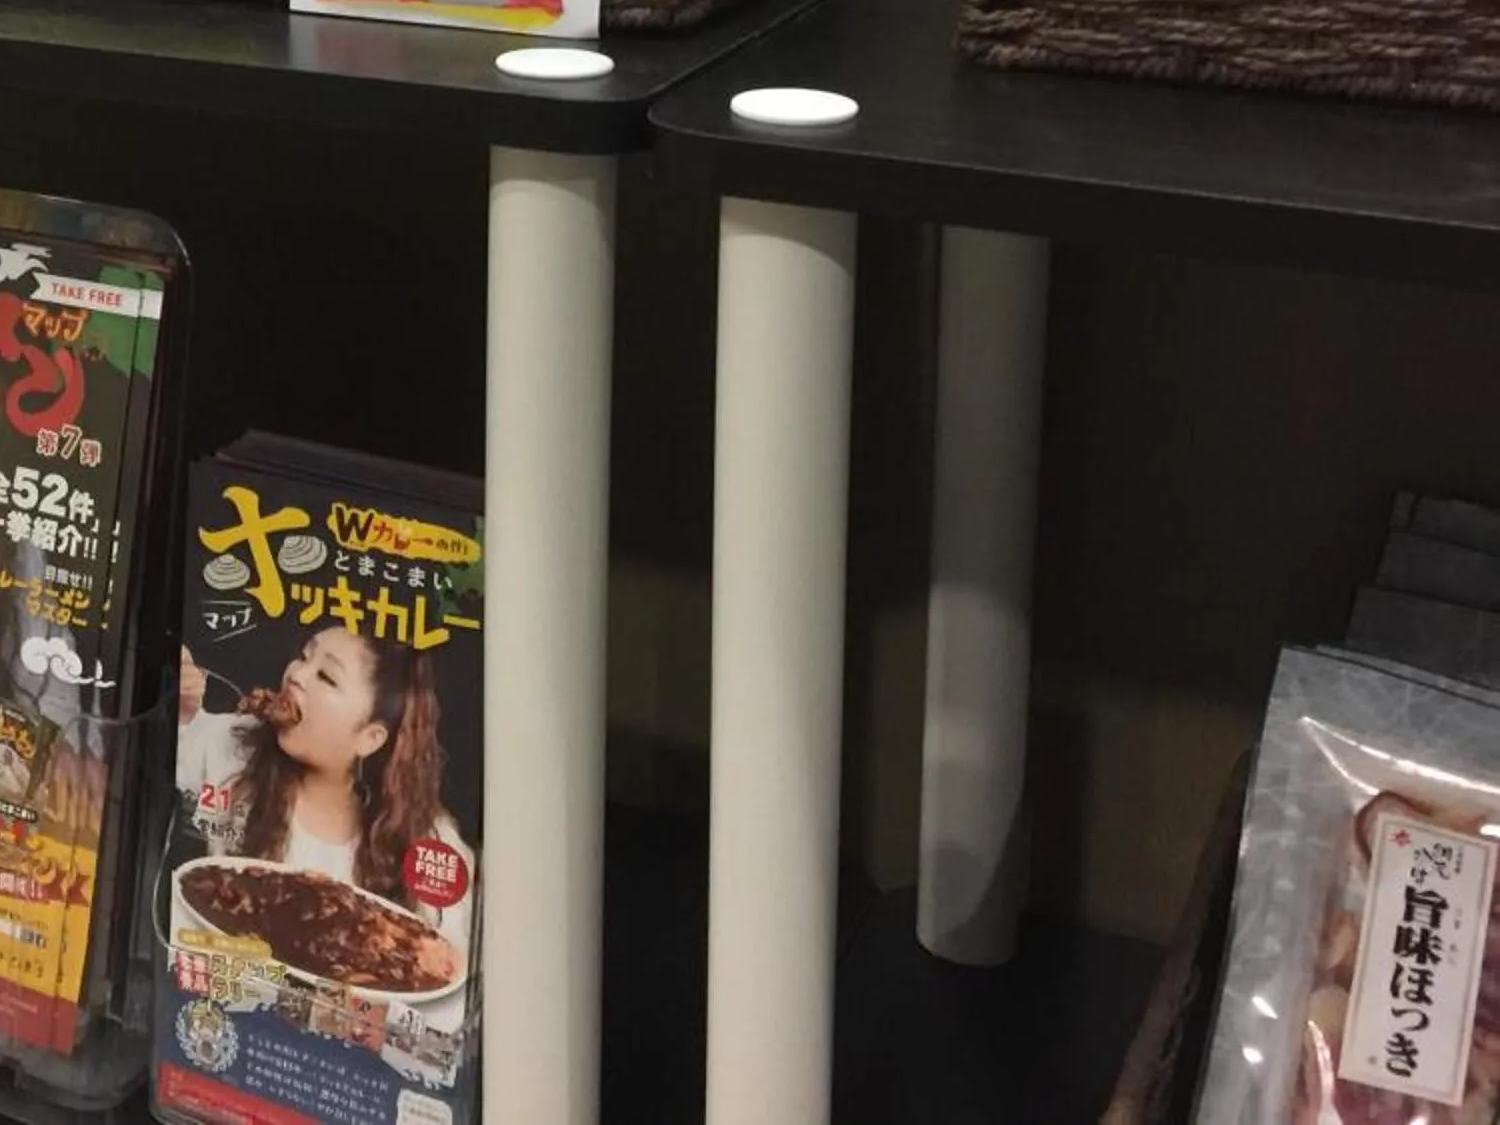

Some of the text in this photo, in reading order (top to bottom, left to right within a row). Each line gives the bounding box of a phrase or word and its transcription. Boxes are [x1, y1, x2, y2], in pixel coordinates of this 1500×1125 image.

[51, 282, 124, 308] TAKE FREE
[332, 549, 453, 591] とまこまい
[415, 846, 459, 868] TAKE
[415, 862, 458, 884] FREE
